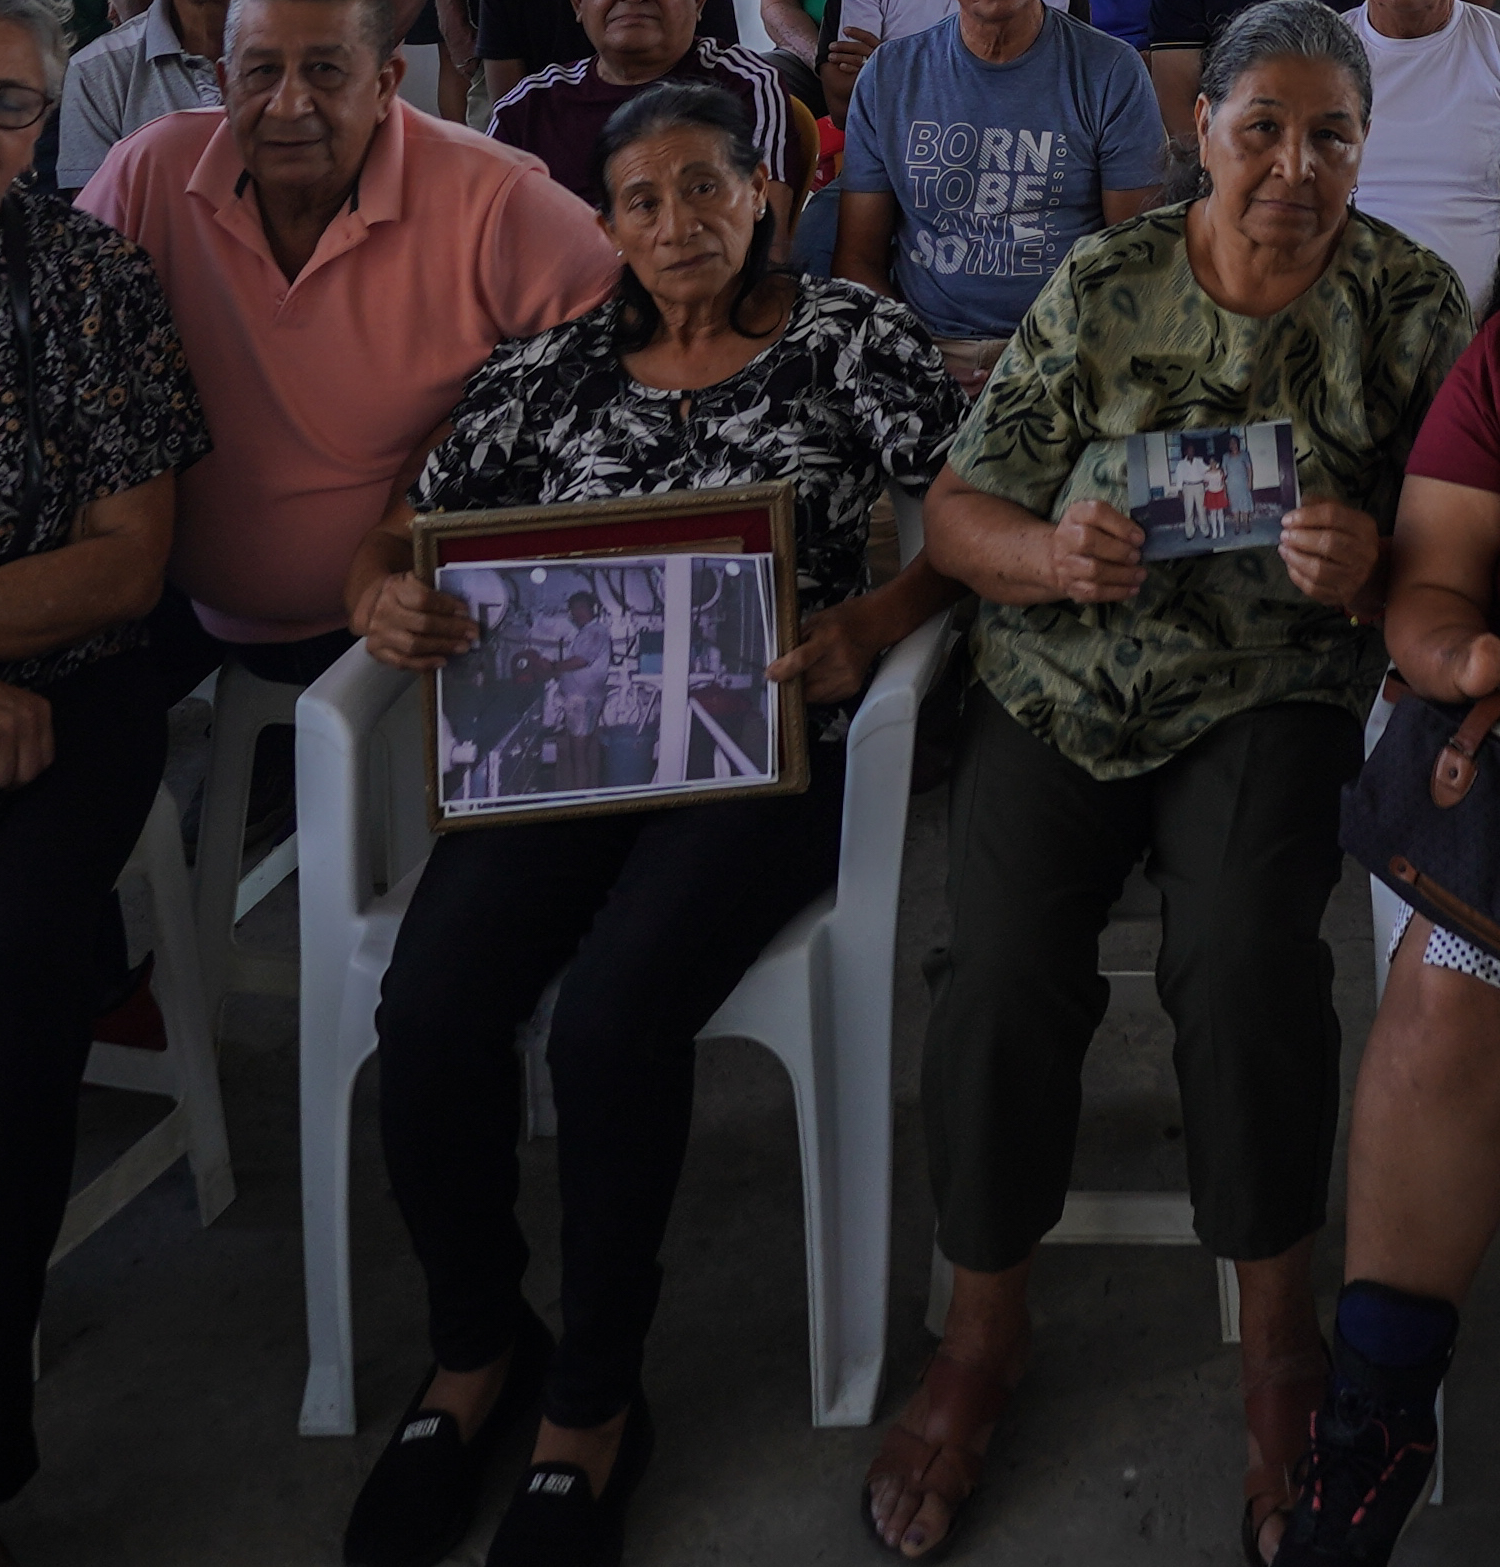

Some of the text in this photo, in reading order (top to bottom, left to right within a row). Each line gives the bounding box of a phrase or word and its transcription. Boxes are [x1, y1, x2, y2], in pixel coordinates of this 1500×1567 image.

[905, 121, 1053, 174] BORN
[908, 165, 1047, 215] TO BE
[910, 229, 1045, 276] SOME
